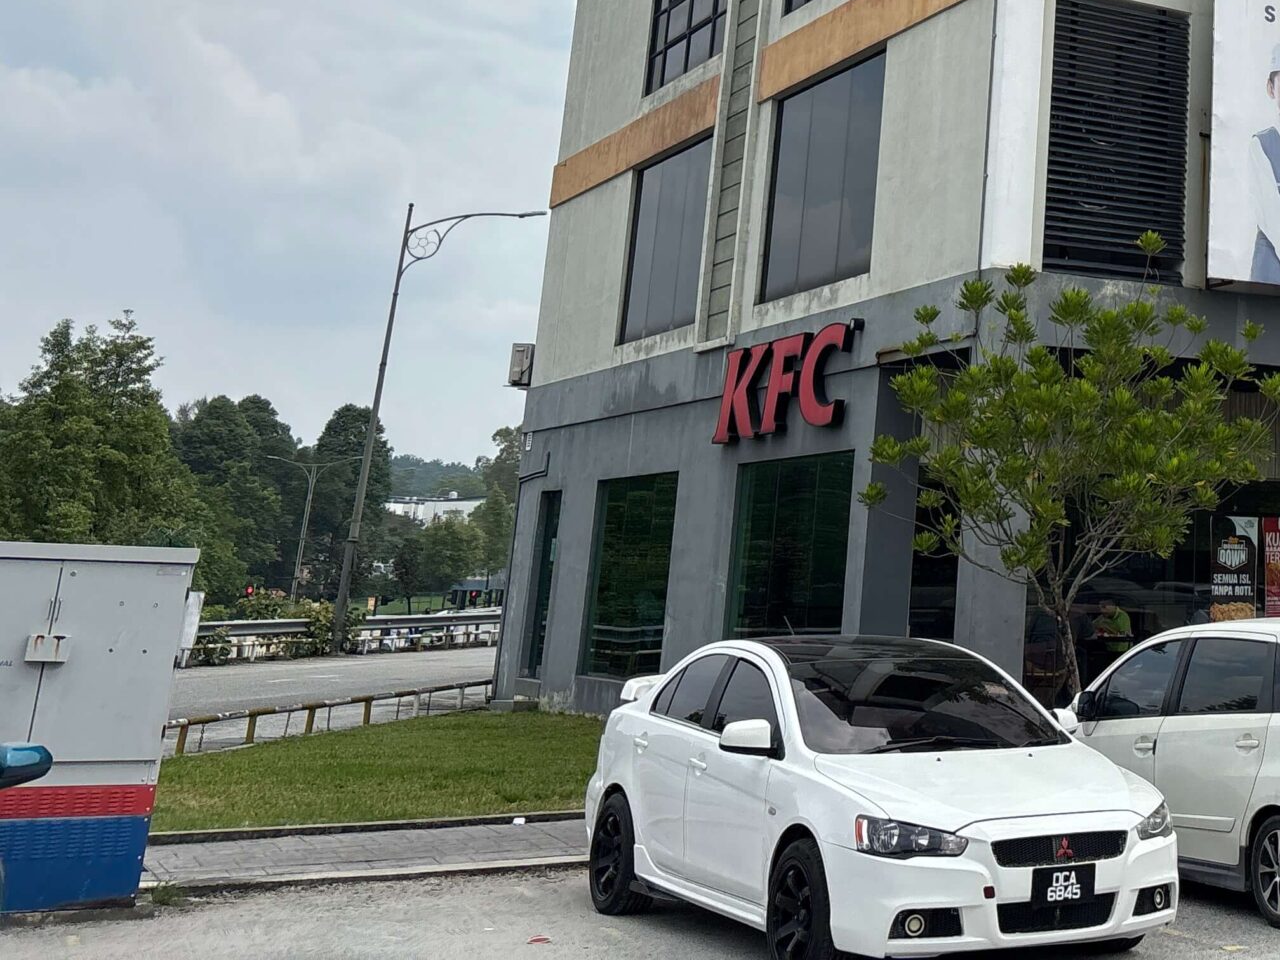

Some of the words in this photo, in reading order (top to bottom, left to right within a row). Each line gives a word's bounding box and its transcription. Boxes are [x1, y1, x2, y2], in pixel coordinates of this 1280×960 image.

[711, 322, 853, 445] KFC
[1219, 549, 1246, 568] DOWN
[1213, 573, 1238, 584] SEMUA
[1211, 585, 1233, 596] TANPA
[1052, 870, 1077, 887] DCA
[1047, 884, 1081, 901] 6845
